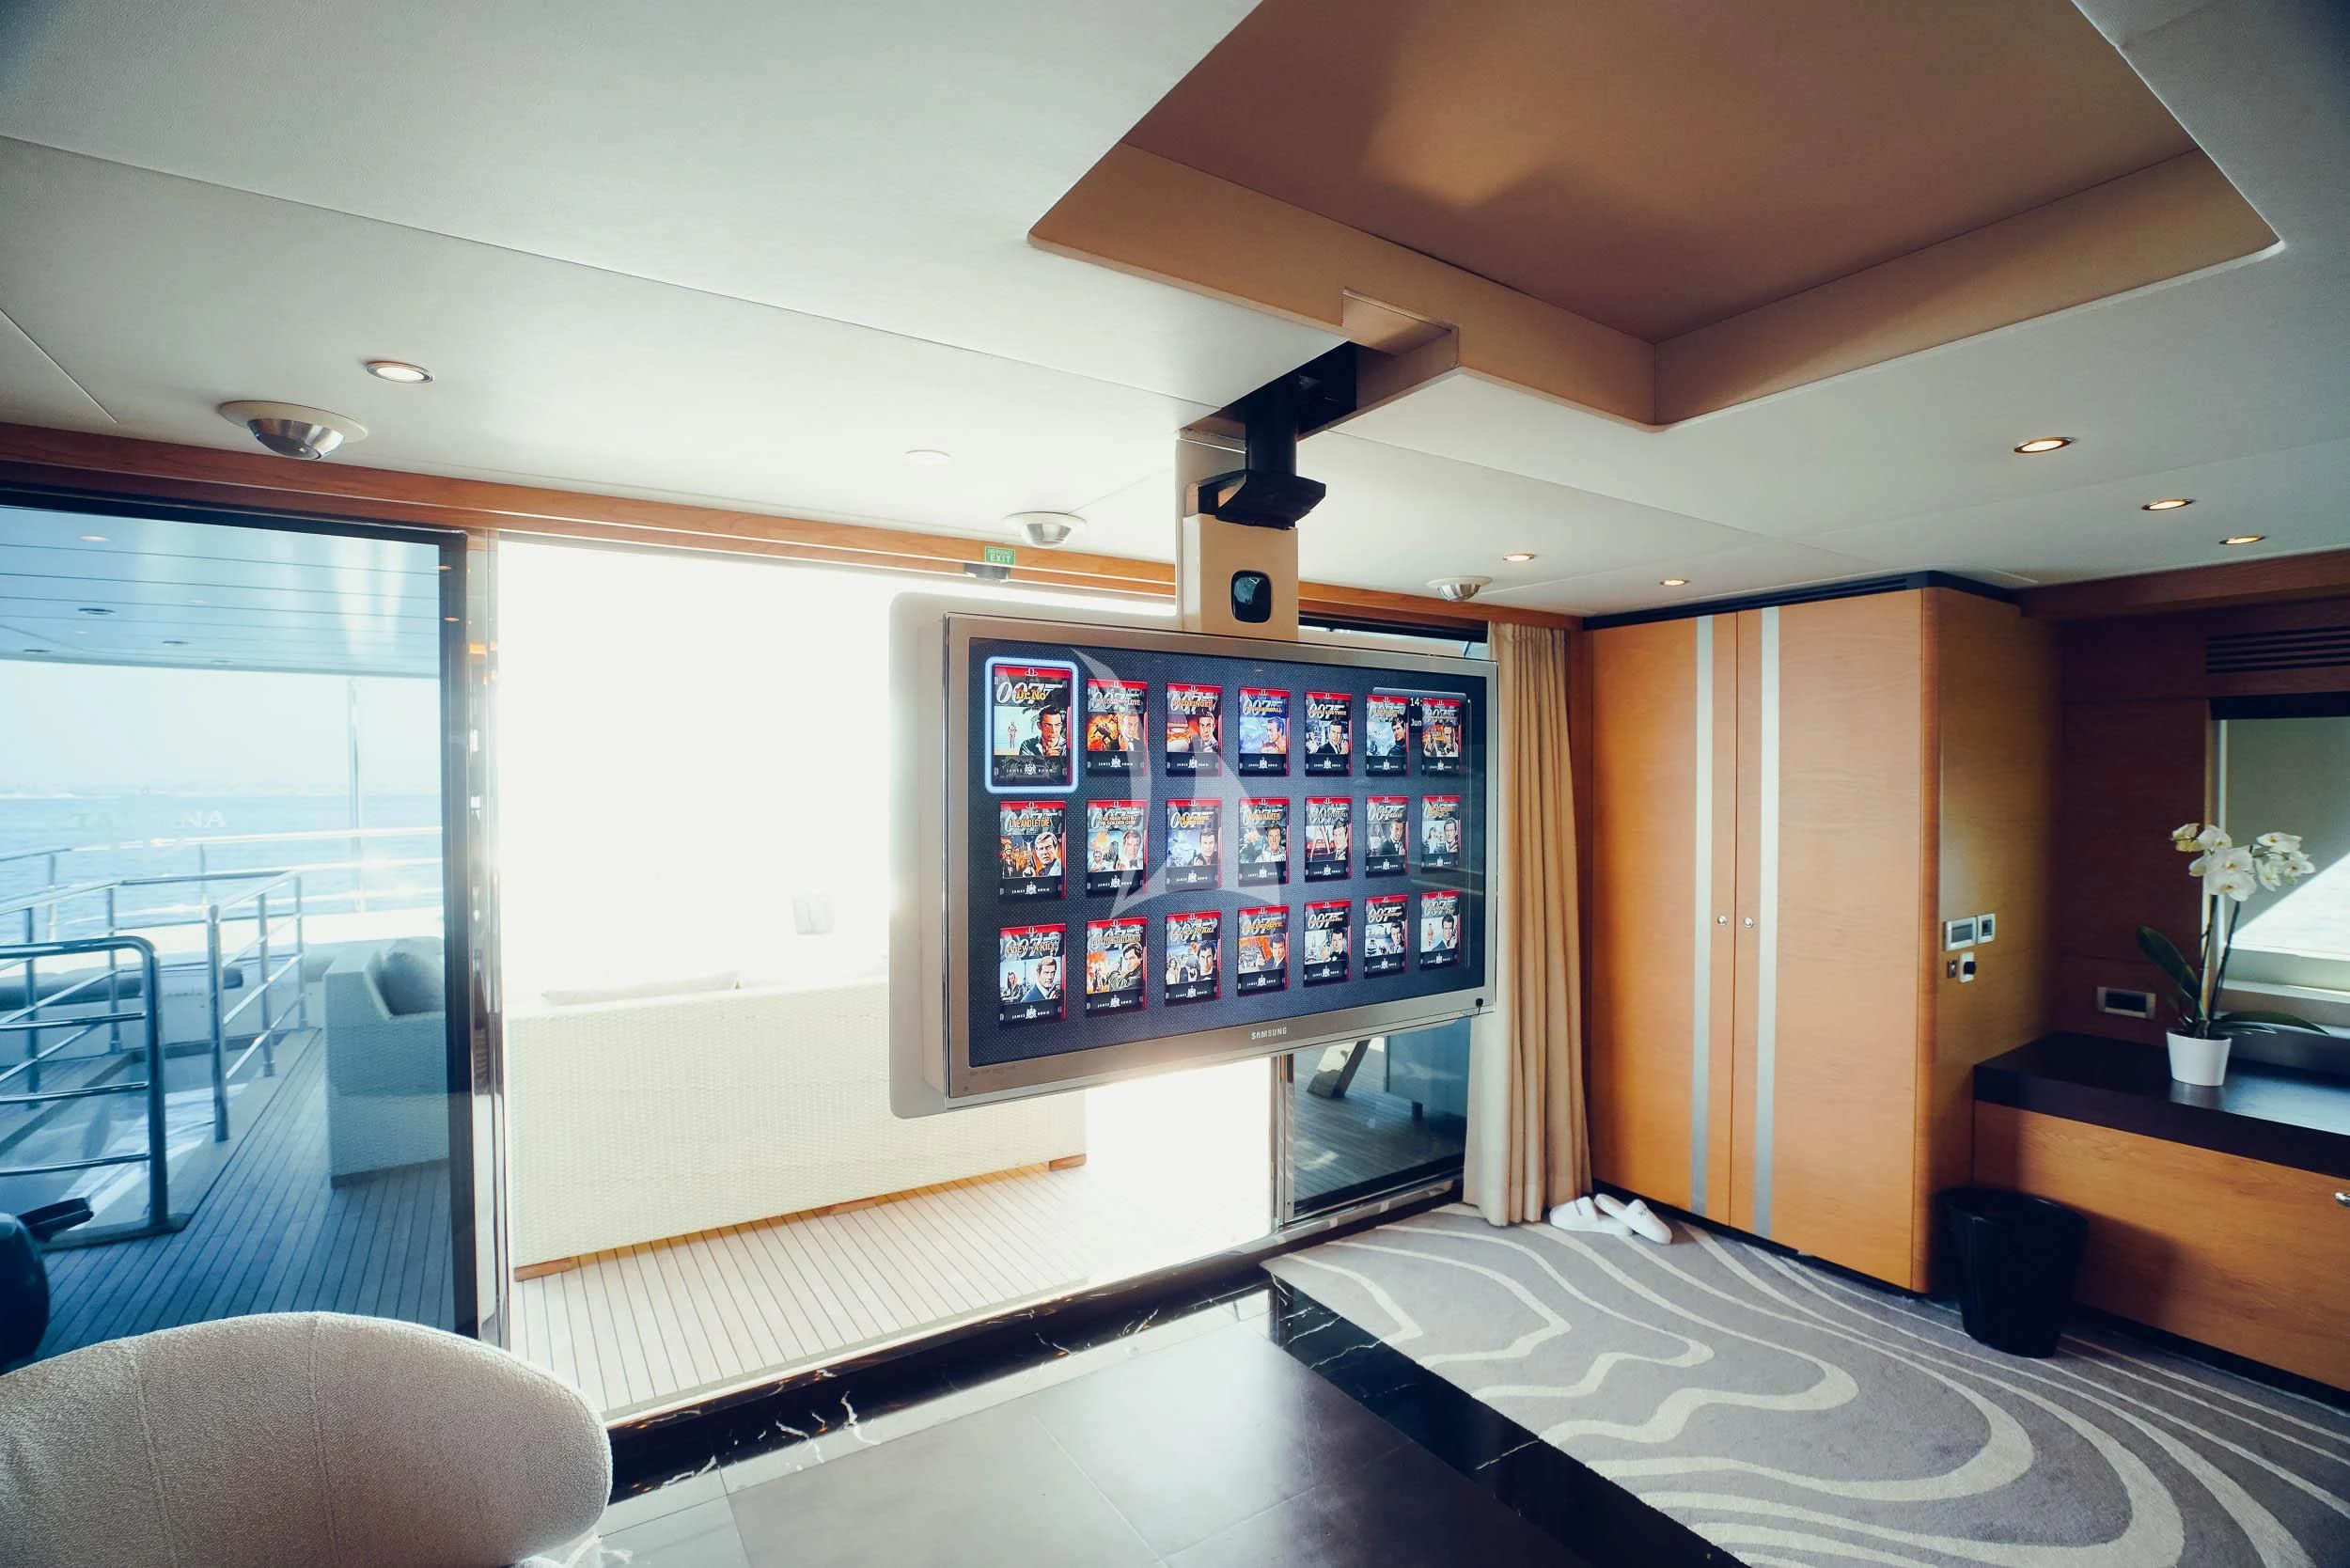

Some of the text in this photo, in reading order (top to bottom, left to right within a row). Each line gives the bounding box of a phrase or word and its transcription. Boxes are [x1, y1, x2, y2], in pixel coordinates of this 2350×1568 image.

[990, 555, 1010, 564] EXIT
[996, 682, 1063, 704] 007
[1308, 703, 1345, 719] 007
[1410, 718, 1422, 727] Jun
[1308, 912, 1345, 929] 007
[1369, 906, 1402, 923] 007
[1251, 1027, 1288, 1040] SAMSUNG
